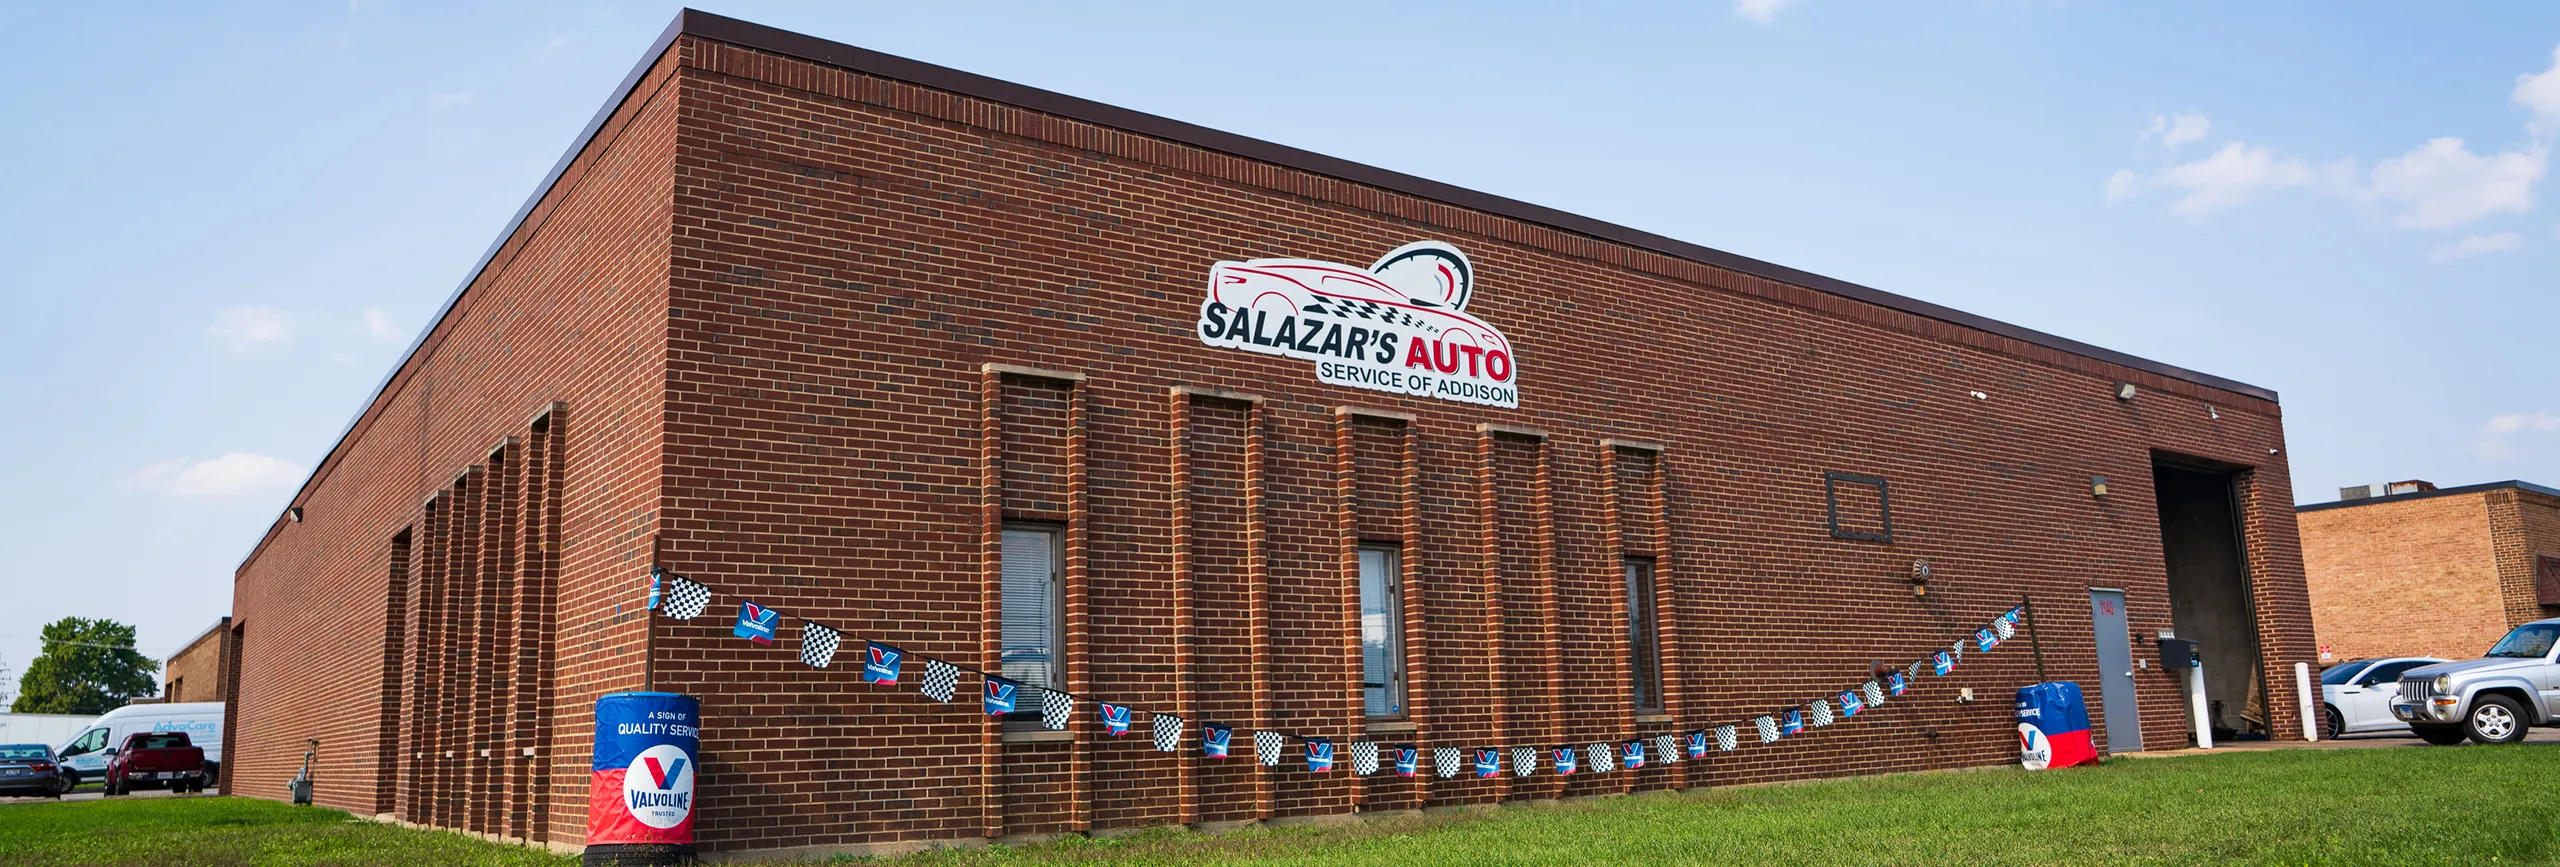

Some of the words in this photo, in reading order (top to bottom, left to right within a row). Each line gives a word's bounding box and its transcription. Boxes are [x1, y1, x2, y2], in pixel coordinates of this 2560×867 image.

[1203, 302, 1398, 364] SALAZAR'S
[1405, 336, 1512, 383] AUTO
[1321, 362, 1402, 387] SERVICE
[1408, 375, 1432, 391] OF
[1437, 379, 1514, 403] ADDISON
[742, 619, 770, 633] Valvoline
[867, 663, 894, 676] Valvoline
[985, 696, 1010, 708] Valvoline
[648, 711, 654, 719] A
[657, 711, 676, 720] SIGN
[2020, 708, 2040, 717] SERVICE
[152, 720, 216, 733] AdvaCare
[618, 722, 668, 735] QUALITY
[669, 724, 699, 739] SERVICE
[631, 788, 689, 810] VALVOLINE
